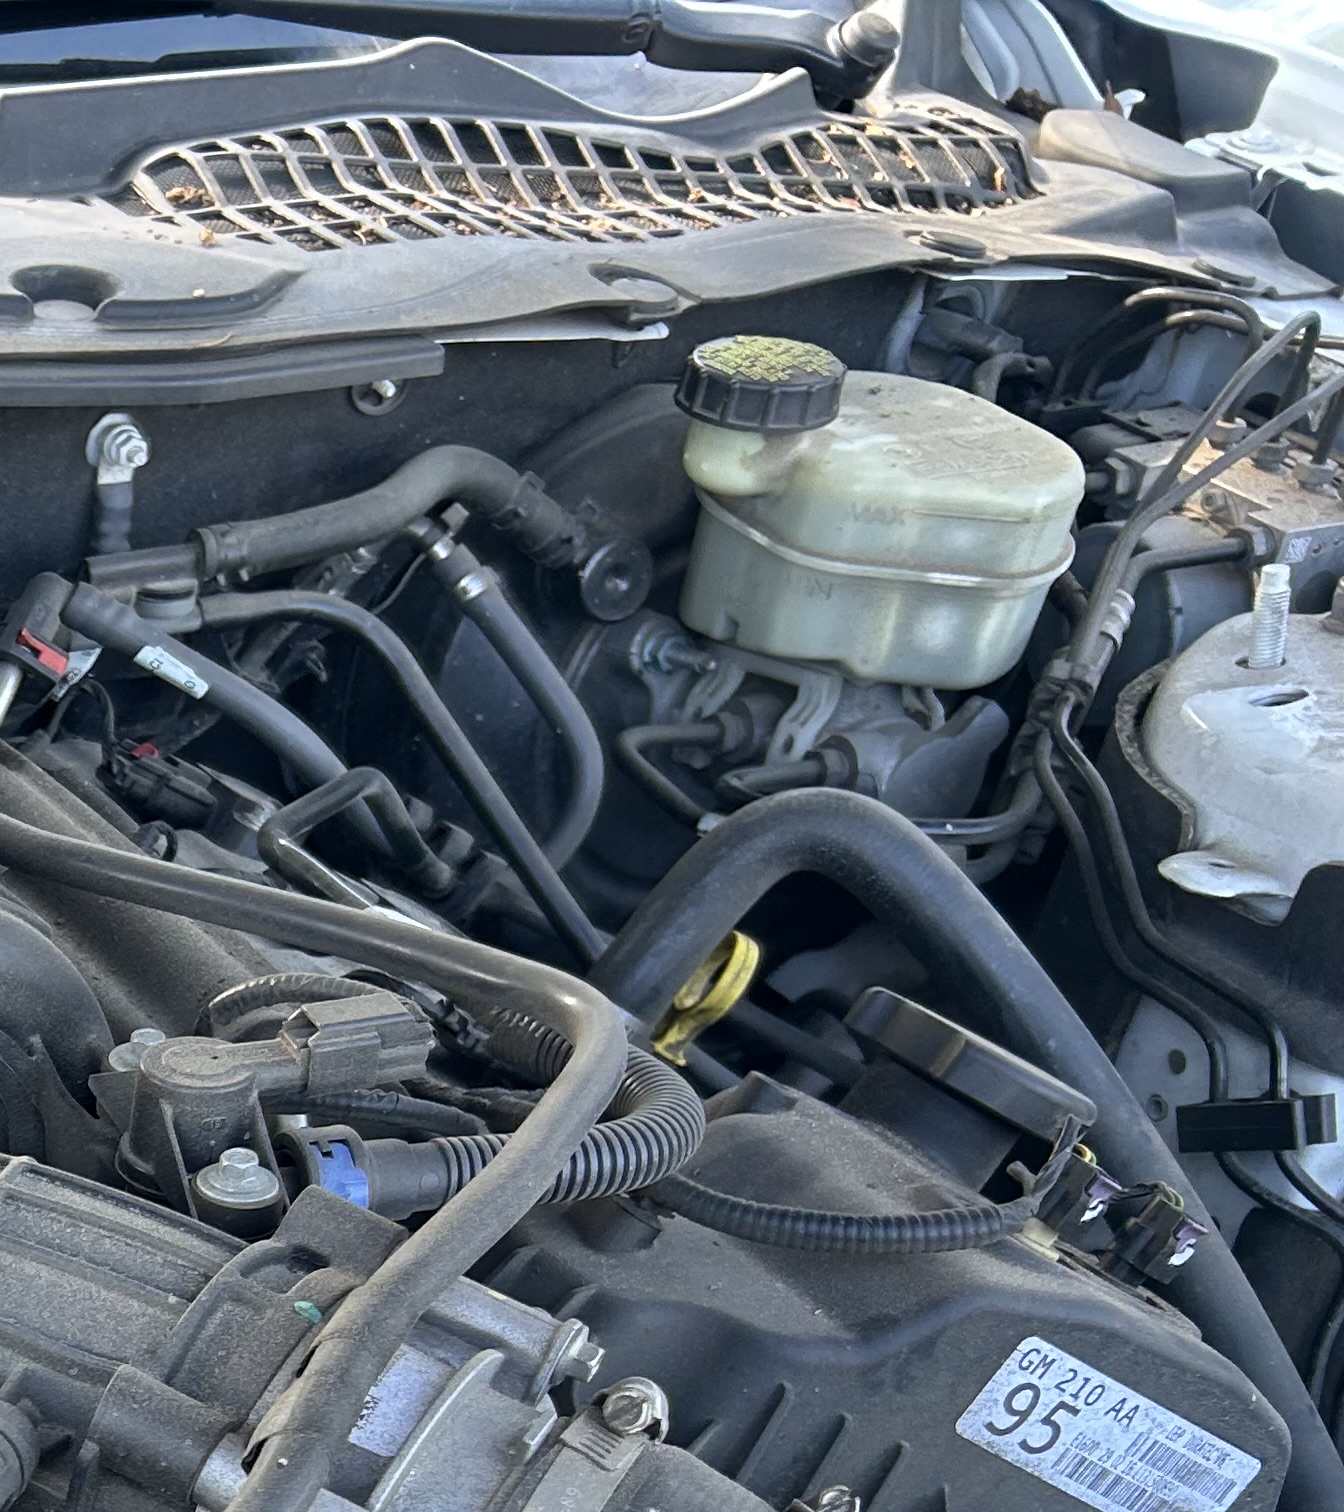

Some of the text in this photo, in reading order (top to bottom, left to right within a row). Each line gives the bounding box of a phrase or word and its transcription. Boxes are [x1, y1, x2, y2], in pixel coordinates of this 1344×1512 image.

[984, 1382, 1082, 1455] 95
[1018, 1347, 1141, 1430] GM 210 AA
